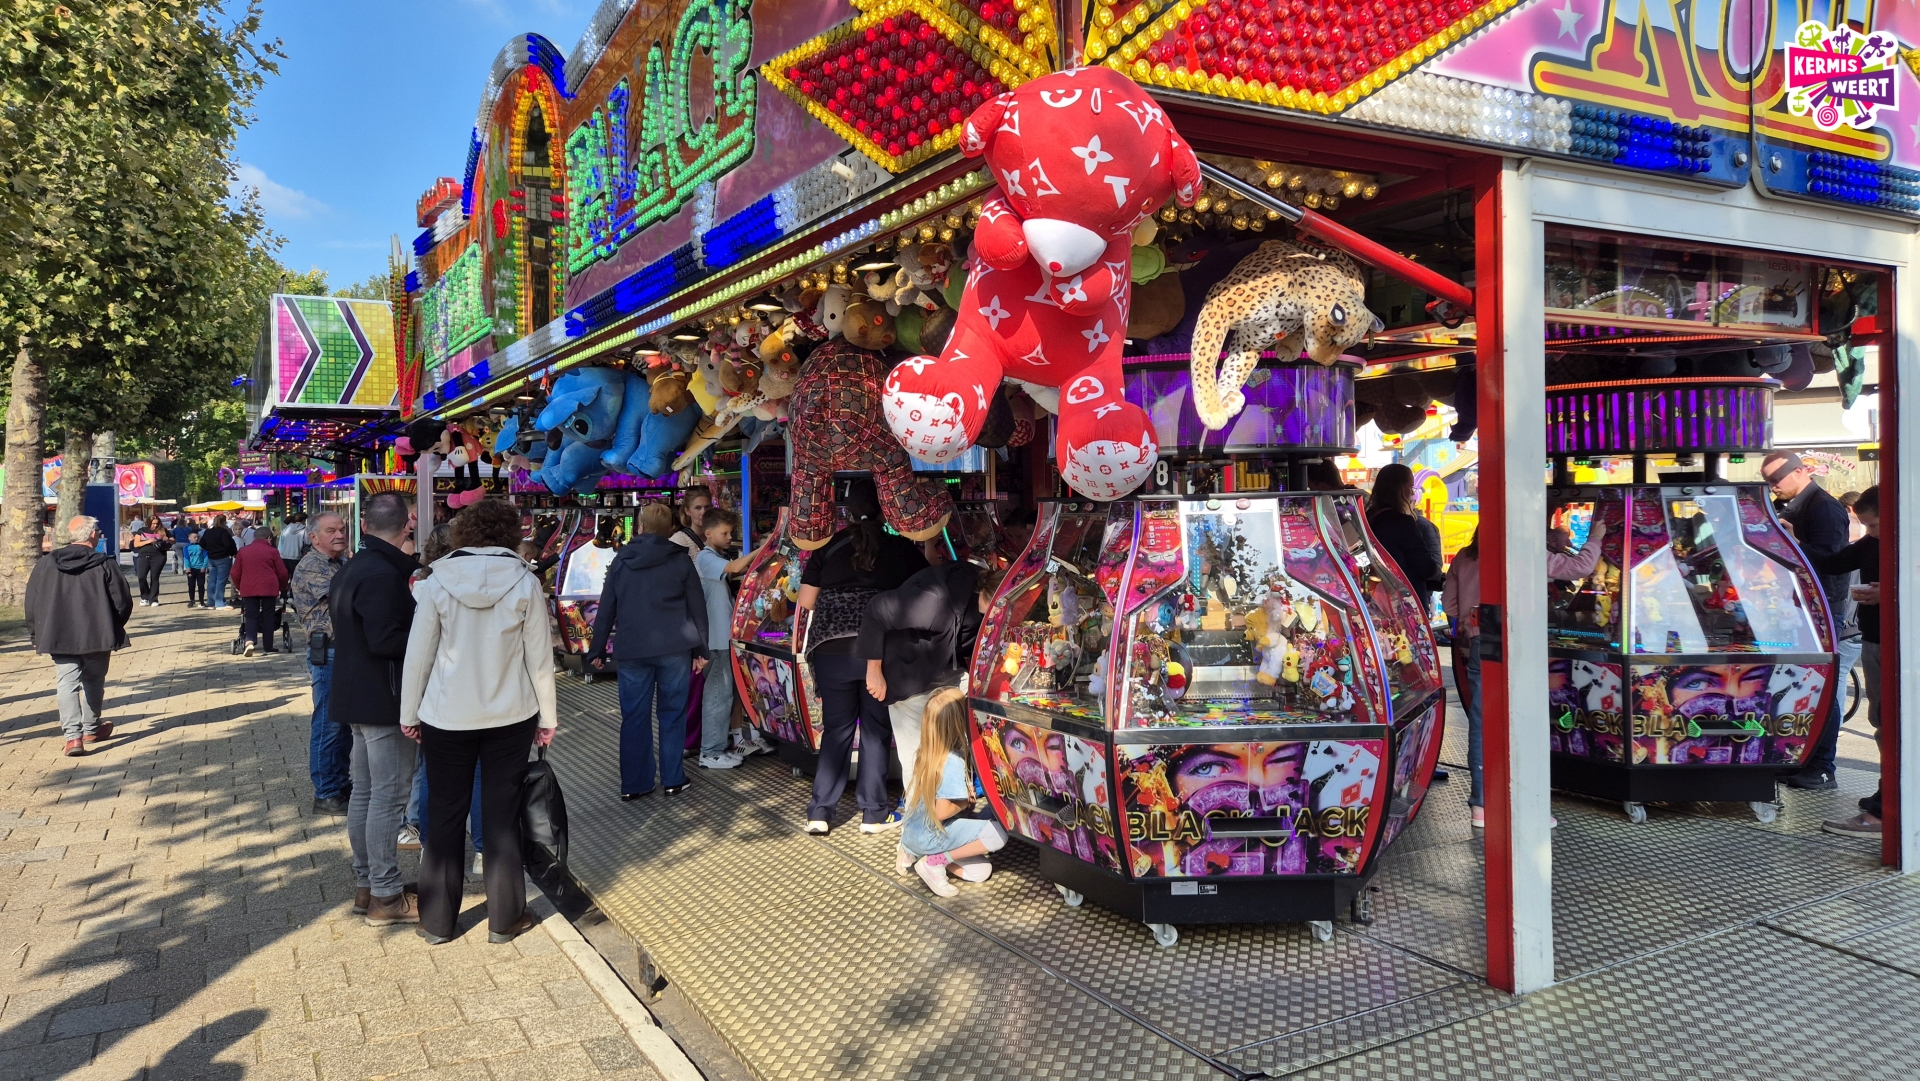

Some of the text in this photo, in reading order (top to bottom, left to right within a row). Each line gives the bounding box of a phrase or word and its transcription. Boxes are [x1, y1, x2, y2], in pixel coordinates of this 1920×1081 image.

[1156, 460, 1169, 486] 8
[844, 480, 852, 498] 7
[566, 626, 594, 639] BLA
